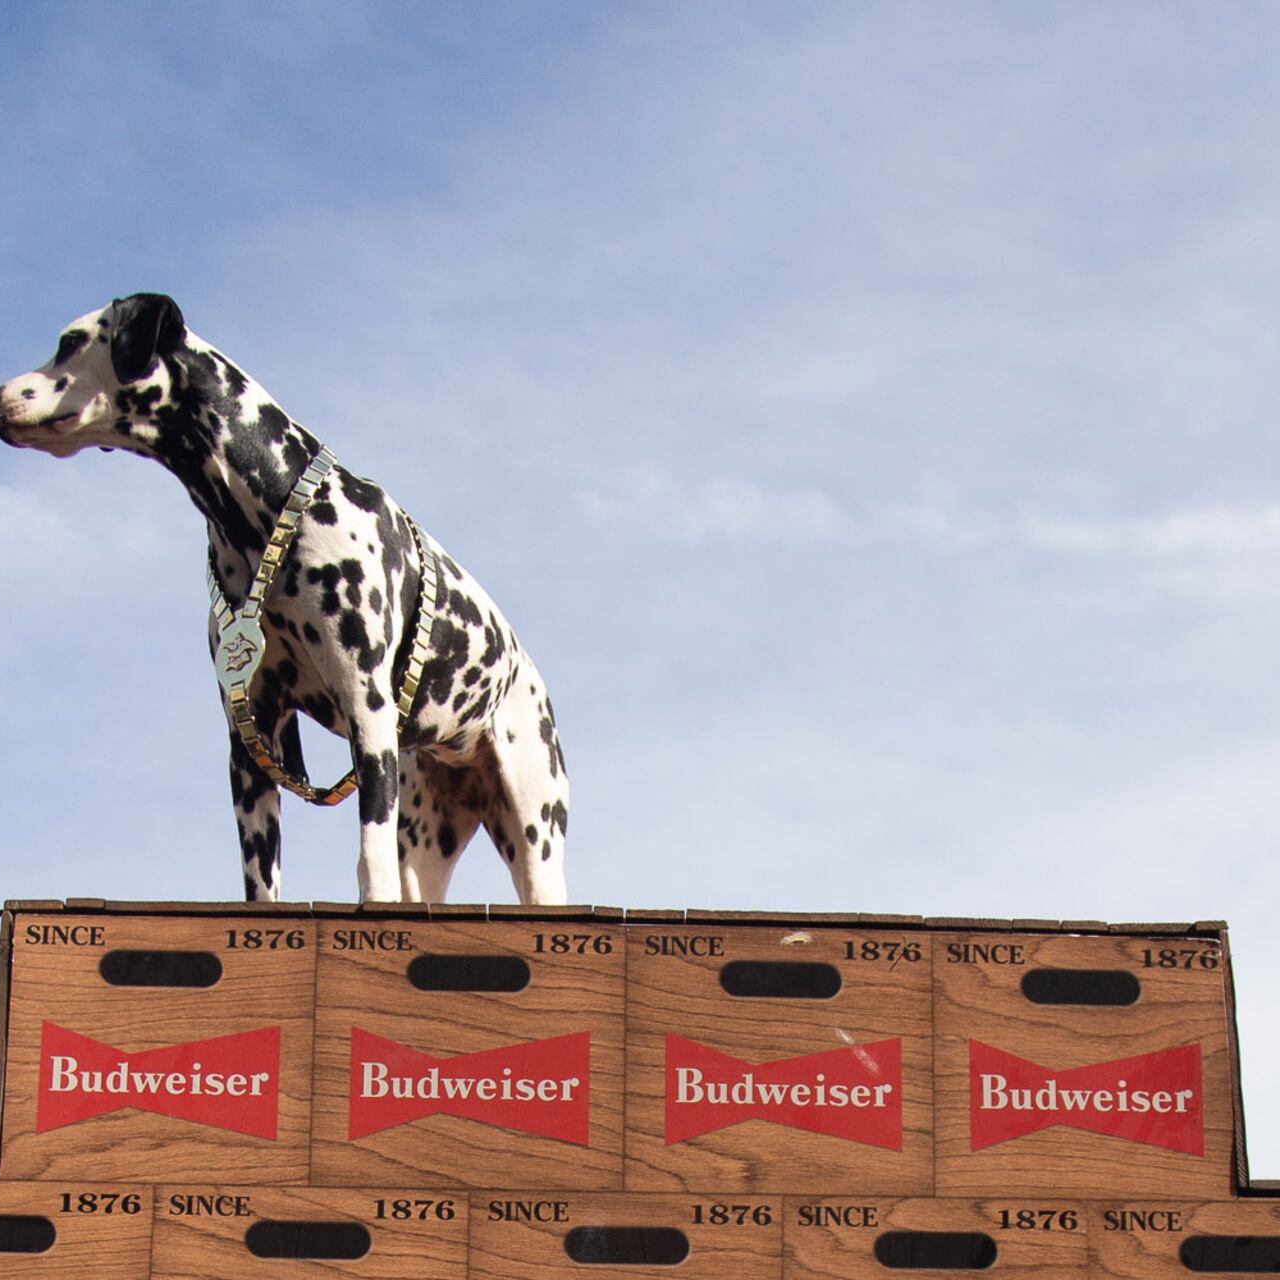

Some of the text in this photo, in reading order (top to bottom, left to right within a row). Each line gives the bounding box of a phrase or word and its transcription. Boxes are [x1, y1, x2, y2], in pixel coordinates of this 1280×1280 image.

[25, 925, 306, 950] SINCE 1876
[333, 930, 613, 955] SINCE 1876
[644, 934, 921, 962] SINCE 1876
[944, 942, 1218, 970] SINCE 1876
[48, 1055, 270, 1096] Budweiser
[360, 1062, 580, 1102] Budweiser
[675, 1067, 893, 1108] Budweiser
[979, 1074, 1193, 1113] Budweiser
[59, 1192, 142, 1215] 1876
[170, 1195, 455, 1221] SINCE 1876
[487, 1199, 773, 1226] SINCE 1876
[797, 1204, 1078, 1230] SINCE 1876
[1104, 1211, 1182, 1232] SINCE
